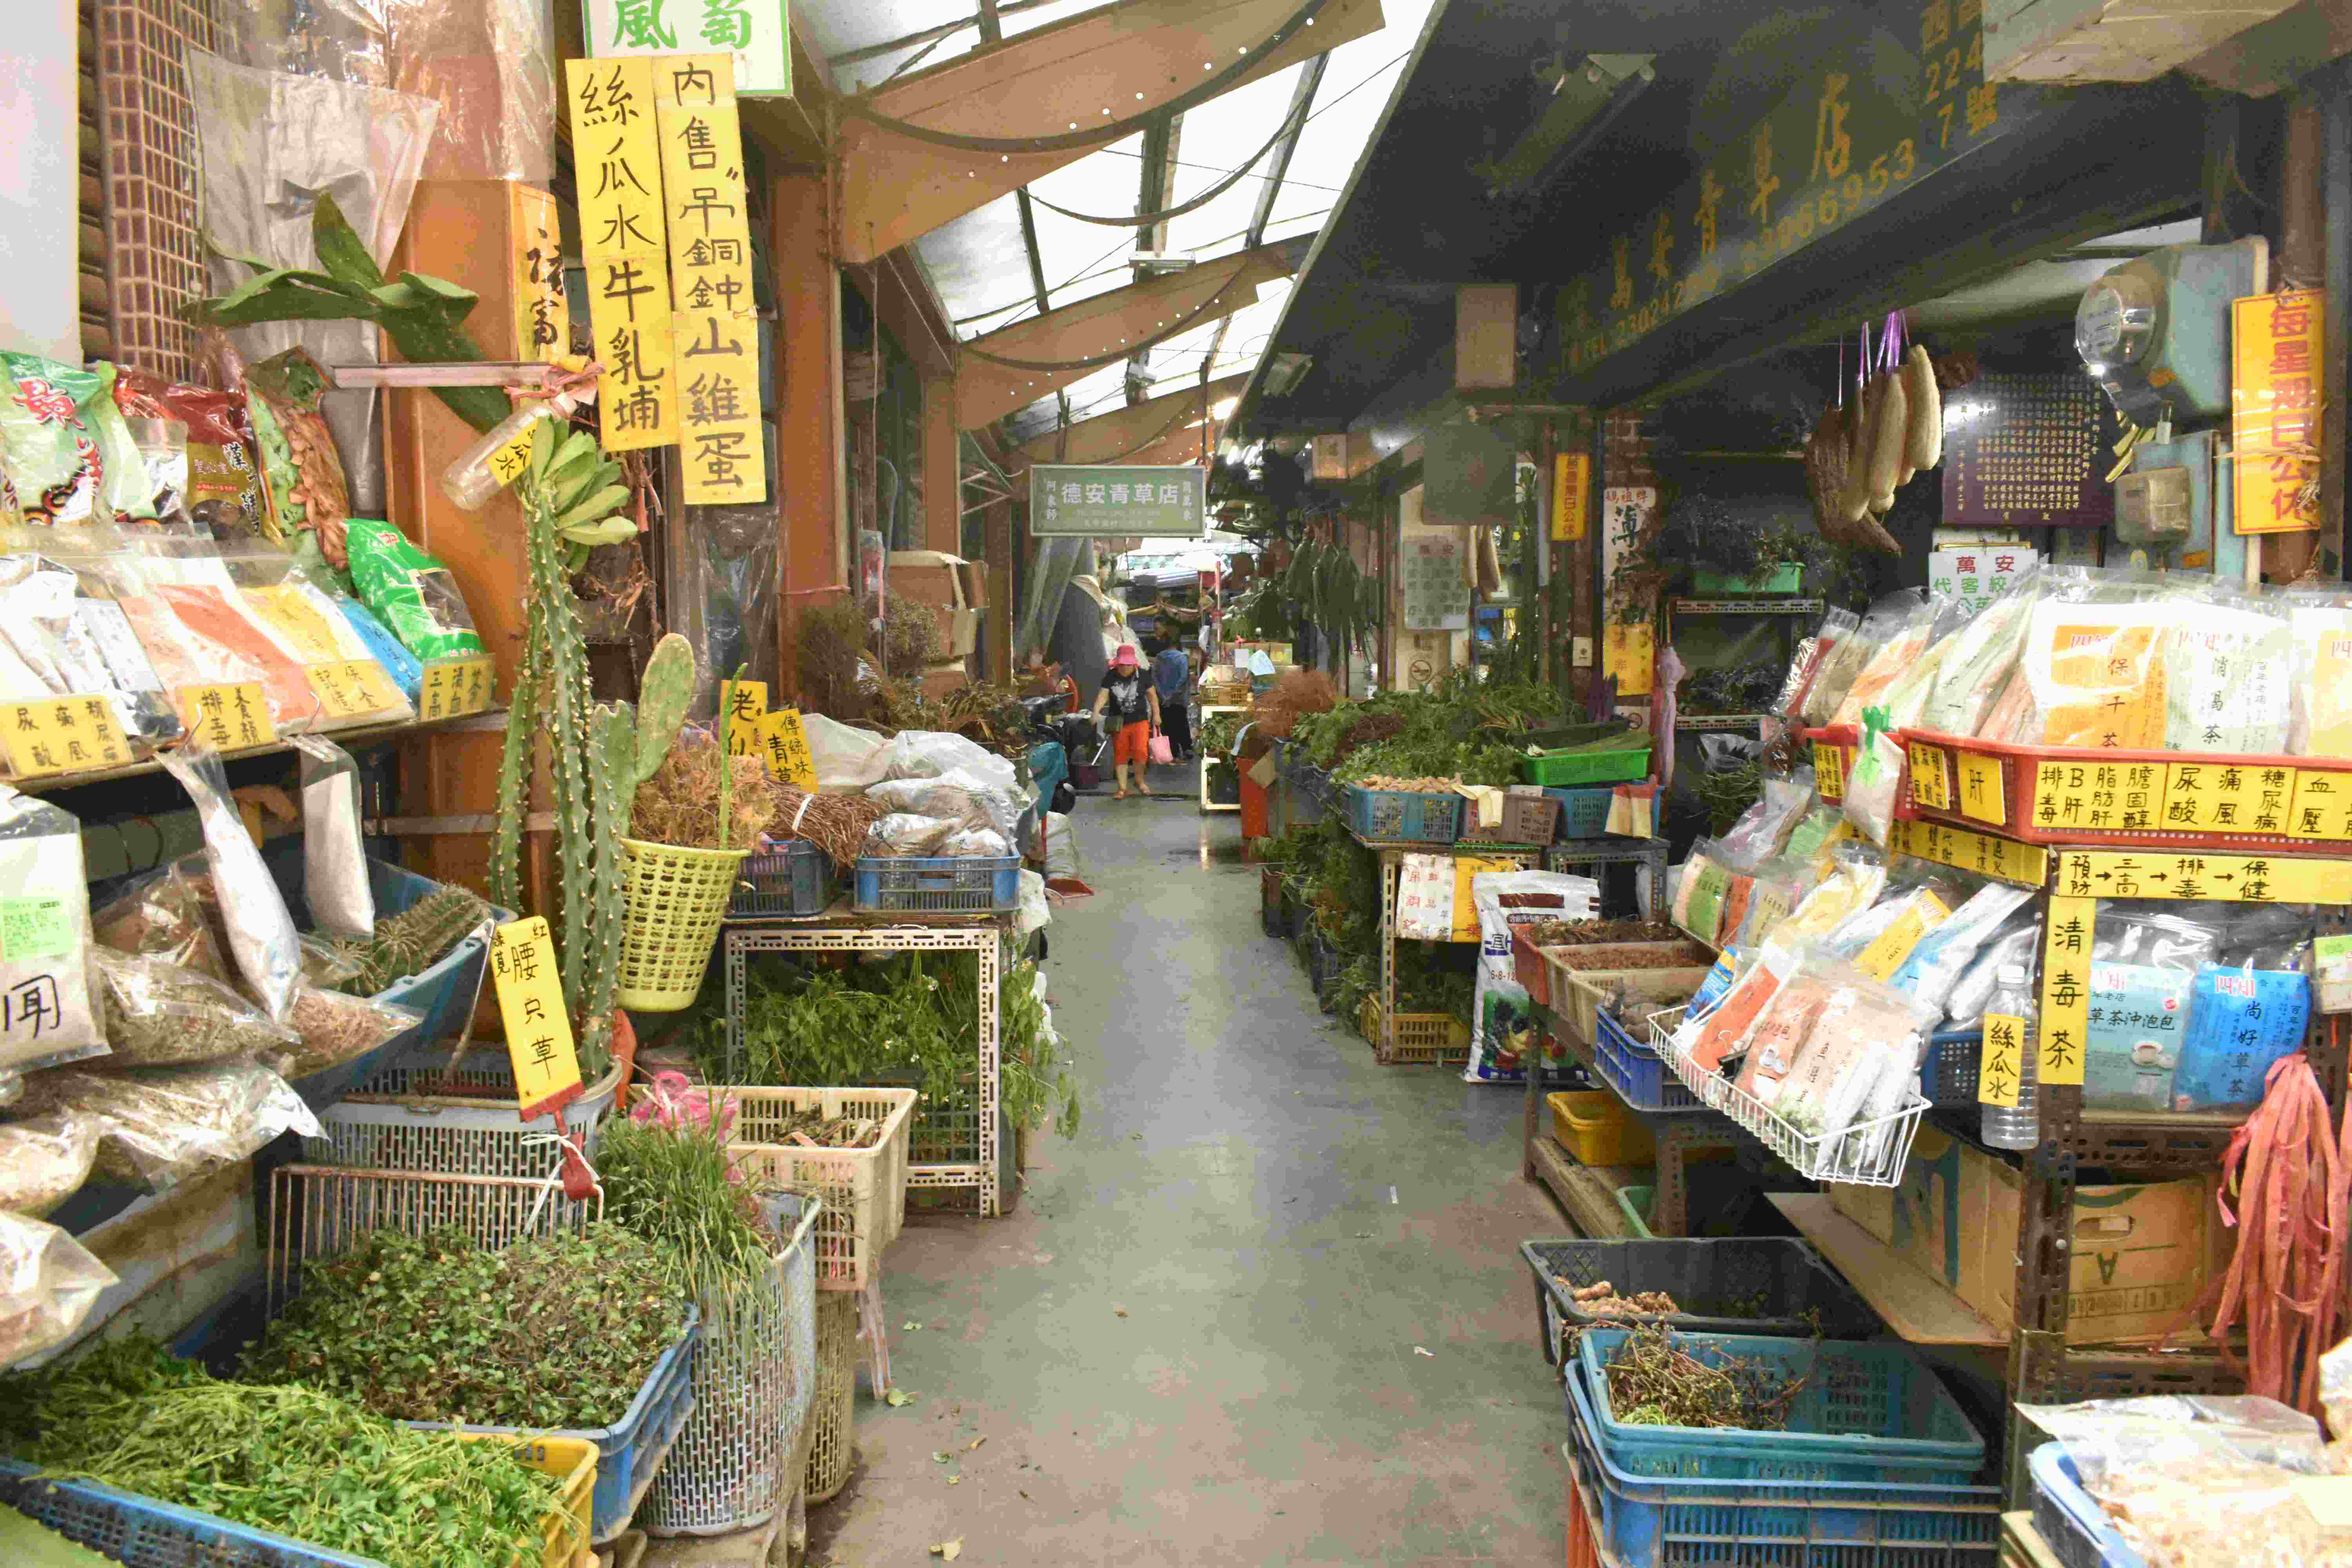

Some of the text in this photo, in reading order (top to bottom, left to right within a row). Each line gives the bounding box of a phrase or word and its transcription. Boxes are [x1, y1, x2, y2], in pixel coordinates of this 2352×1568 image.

[1061, 482, 1179, 505] 德安青草店
[1956, 555, 2014, 574] 萬安
[767, 732, 797, 784] 青草
[780, 714, 814, 779] 傳統味
[2039, 766, 2064, 824] 排毒
[2063, 767, 2085, 824] B肝
[2089, 766, 2117, 826] 脂肪肝
[2122, 766, 2155, 829] 膽固醇
[2167, 766, 2203, 826] 尿酸
[2211, 767, 2243, 825] 痛風
[2254, 769, 2286, 831] 糖尿病
[2297, 777, 2337, 833] 血壓
[2070, 855, 2092, 895] 預防
[2113, 857, 2143, 895] 三高
[2170, 858, 2207, 898] 排毒
[2239, 860, 2276, 901] 保健
[511, 940, 558, 1080] 腰只草
[2043, 916, 2087, 1069] 清毒茶
[1985, 1020, 2019, 1100] 絲瓜水
